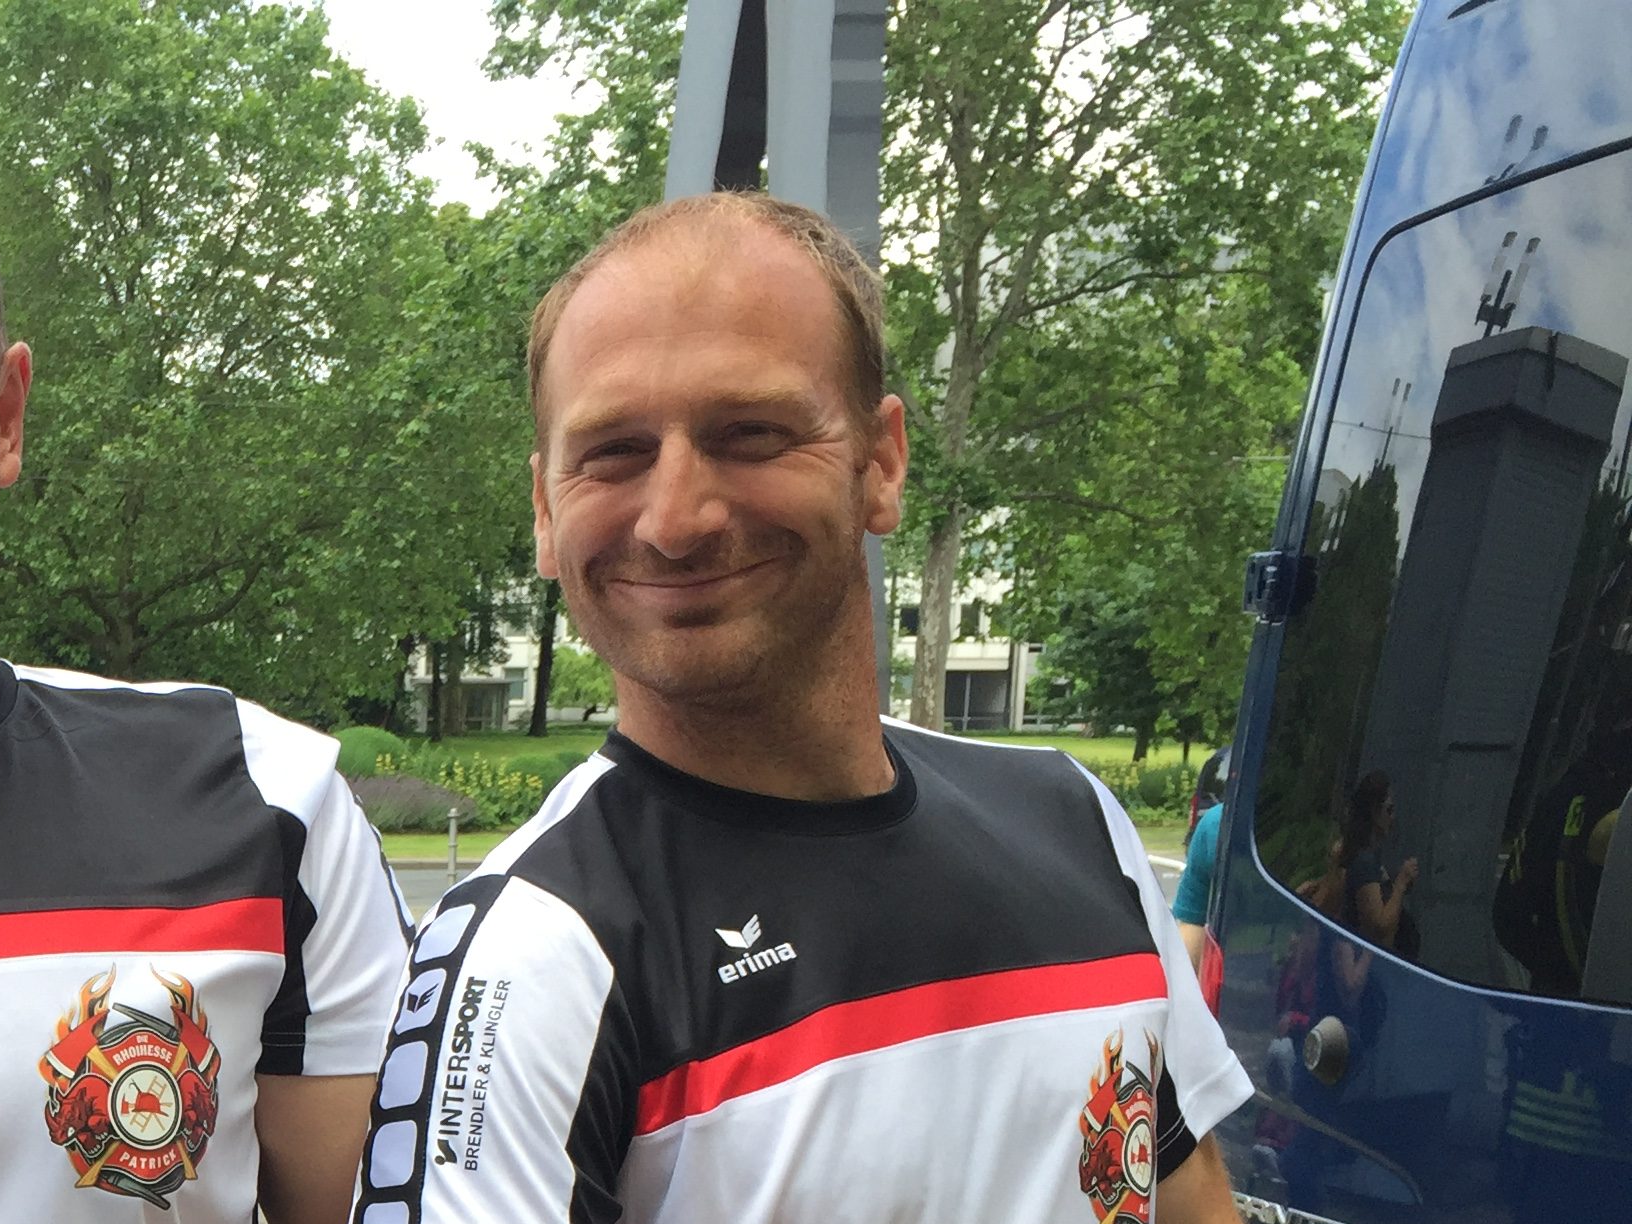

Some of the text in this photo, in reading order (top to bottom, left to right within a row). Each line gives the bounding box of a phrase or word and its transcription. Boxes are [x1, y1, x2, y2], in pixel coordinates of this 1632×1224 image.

[717, 942, 797, 984] erima
[438, 976, 488, 1136] INTERSPORT
[465, 979, 512, 1171] BRENDLER & KLINGLER
[119, 1149, 177, 1169] PATRICK
